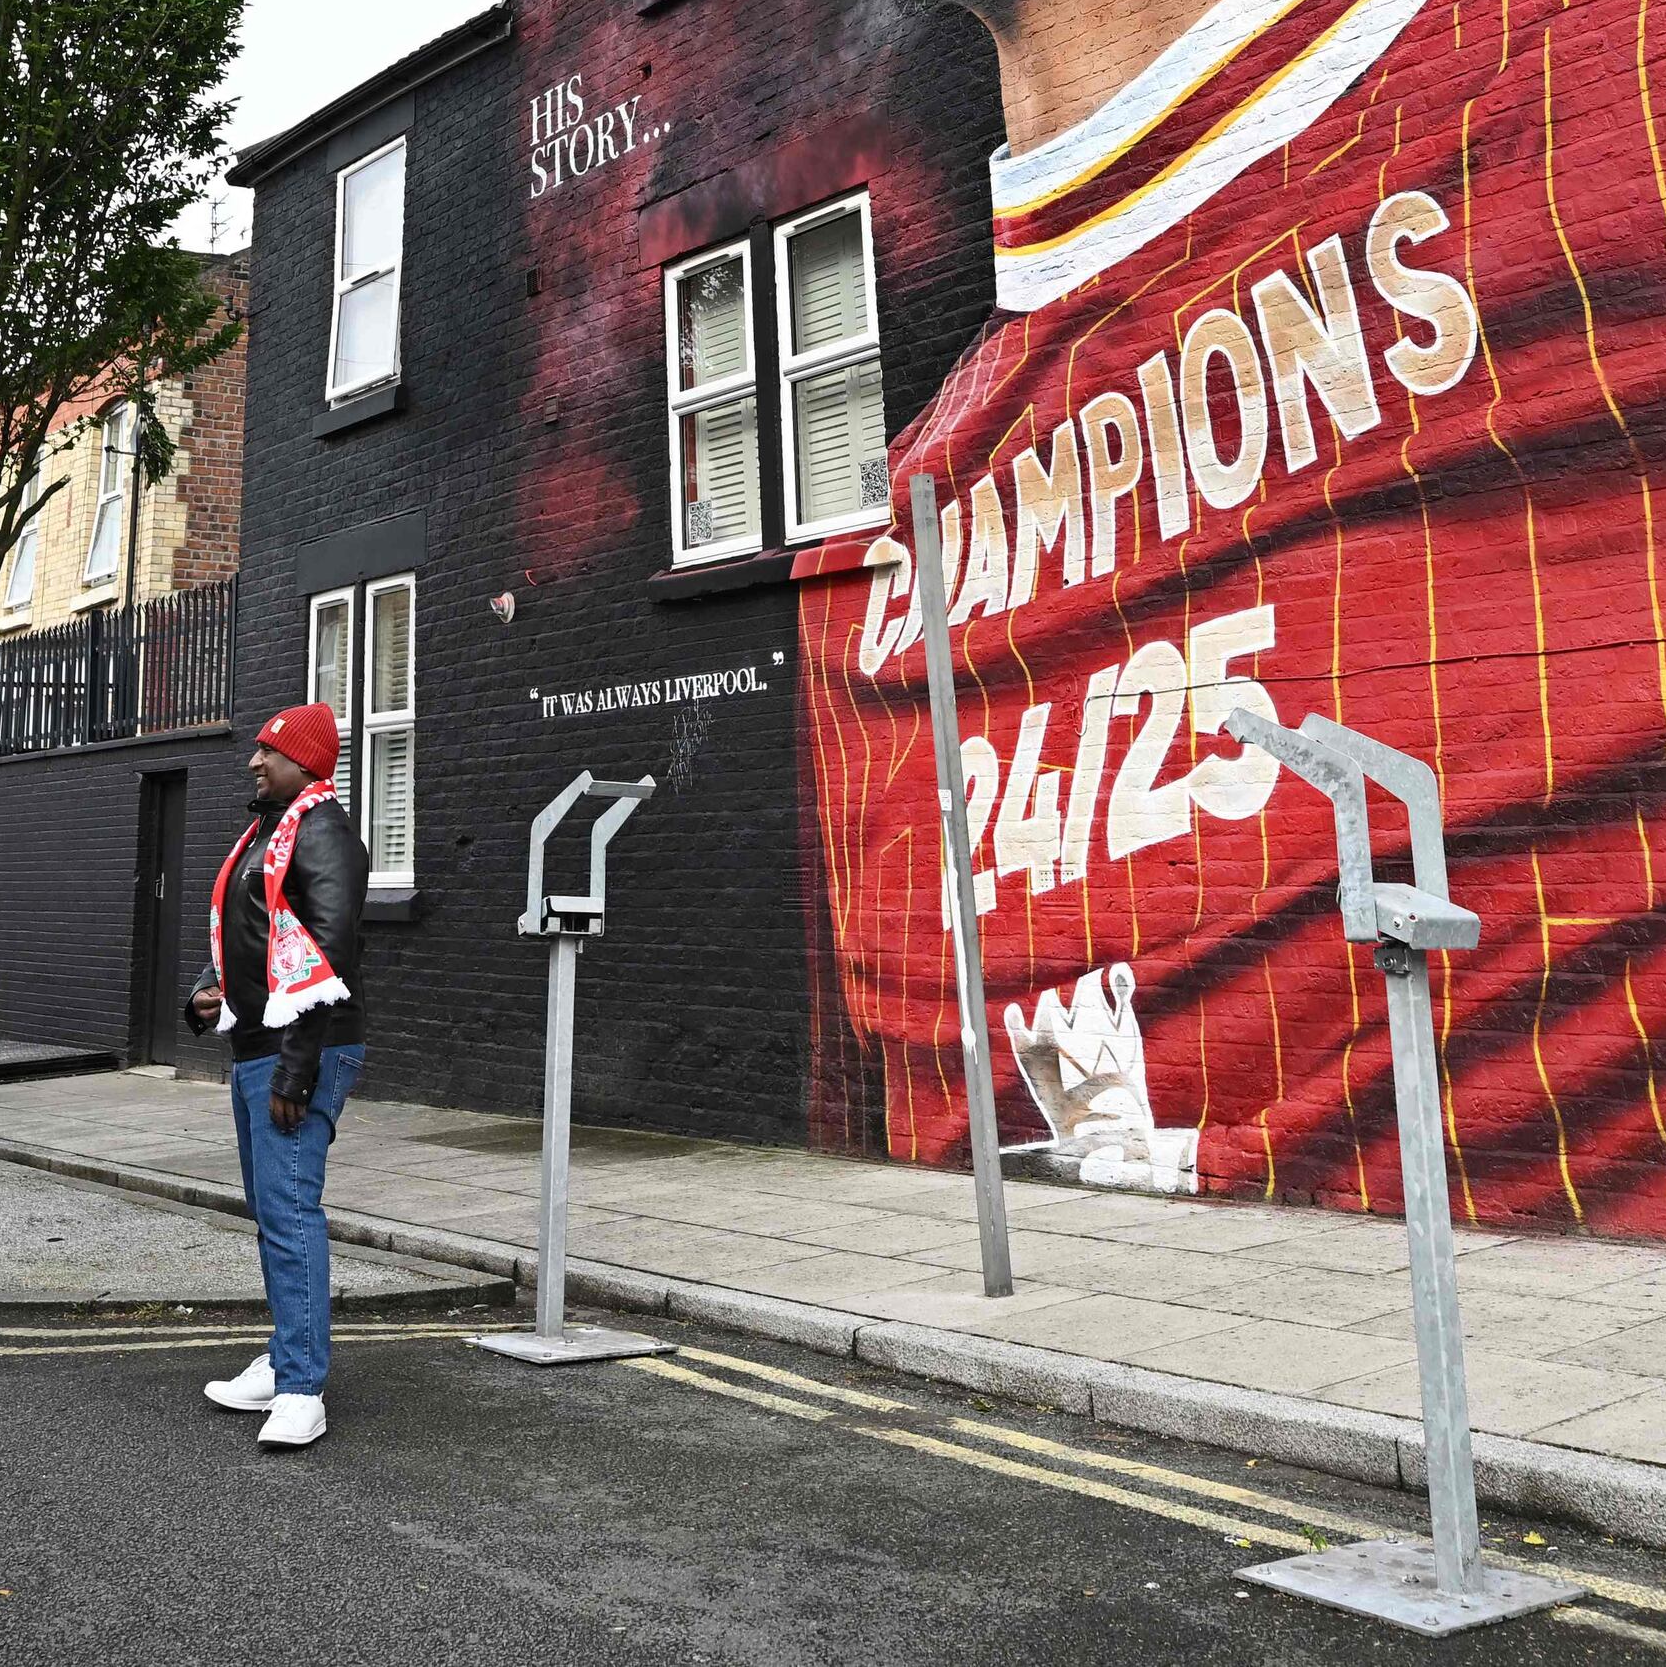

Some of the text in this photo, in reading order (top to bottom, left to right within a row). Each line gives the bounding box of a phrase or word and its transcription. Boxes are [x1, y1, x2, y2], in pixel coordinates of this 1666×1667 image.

[530, 72, 584, 146] HIS
[530, 94, 671, 199] STORY...
[560, 695, 594, 716] WAS
[596, 679, 662, 712] ALWAYS
[941, 604, 1282, 932] 24/25
